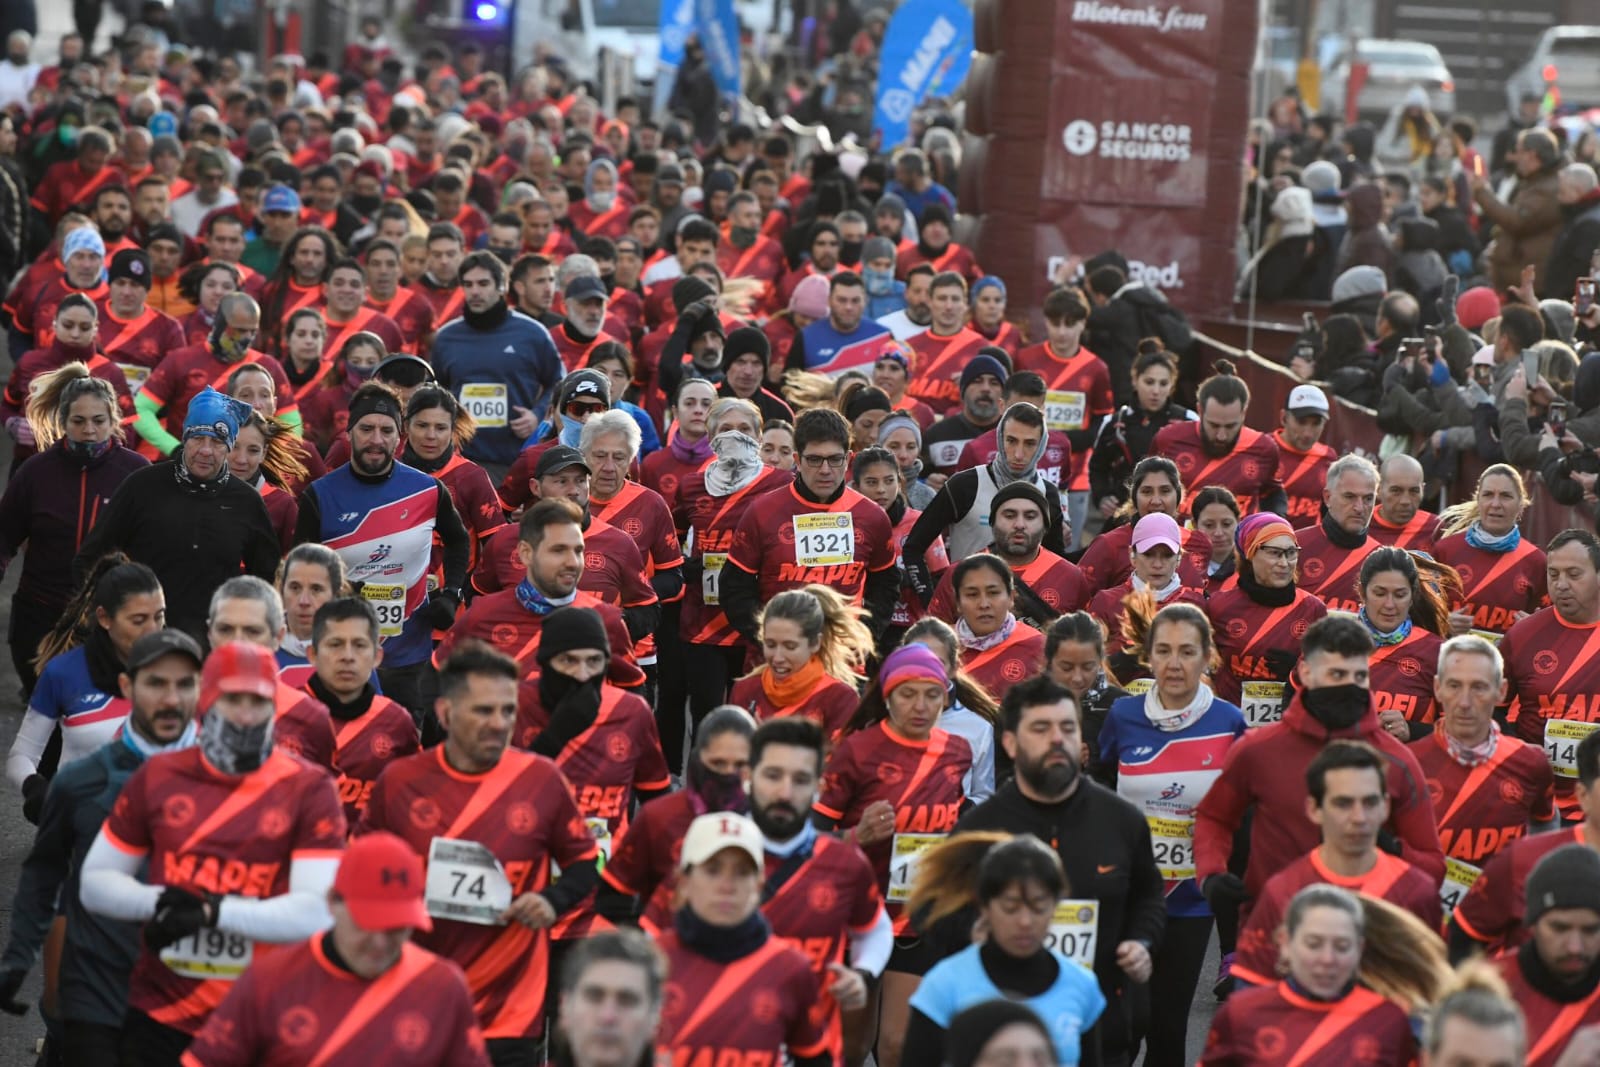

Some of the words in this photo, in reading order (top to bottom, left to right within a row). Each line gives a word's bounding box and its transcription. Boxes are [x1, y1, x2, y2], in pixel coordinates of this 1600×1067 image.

[1072, 1, 1162, 27] Biotenk
[1101, 120, 1192, 143] SANCOR
[1100, 140, 1191, 162] SEGUROS
[1046, 407, 1082, 421] 1299
[801, 533, 850, 553] 1321
[778, 562, 864, 586] MAPEI
[376, 605, 402, 624] 39
[451, 871, 485, 899] 74
